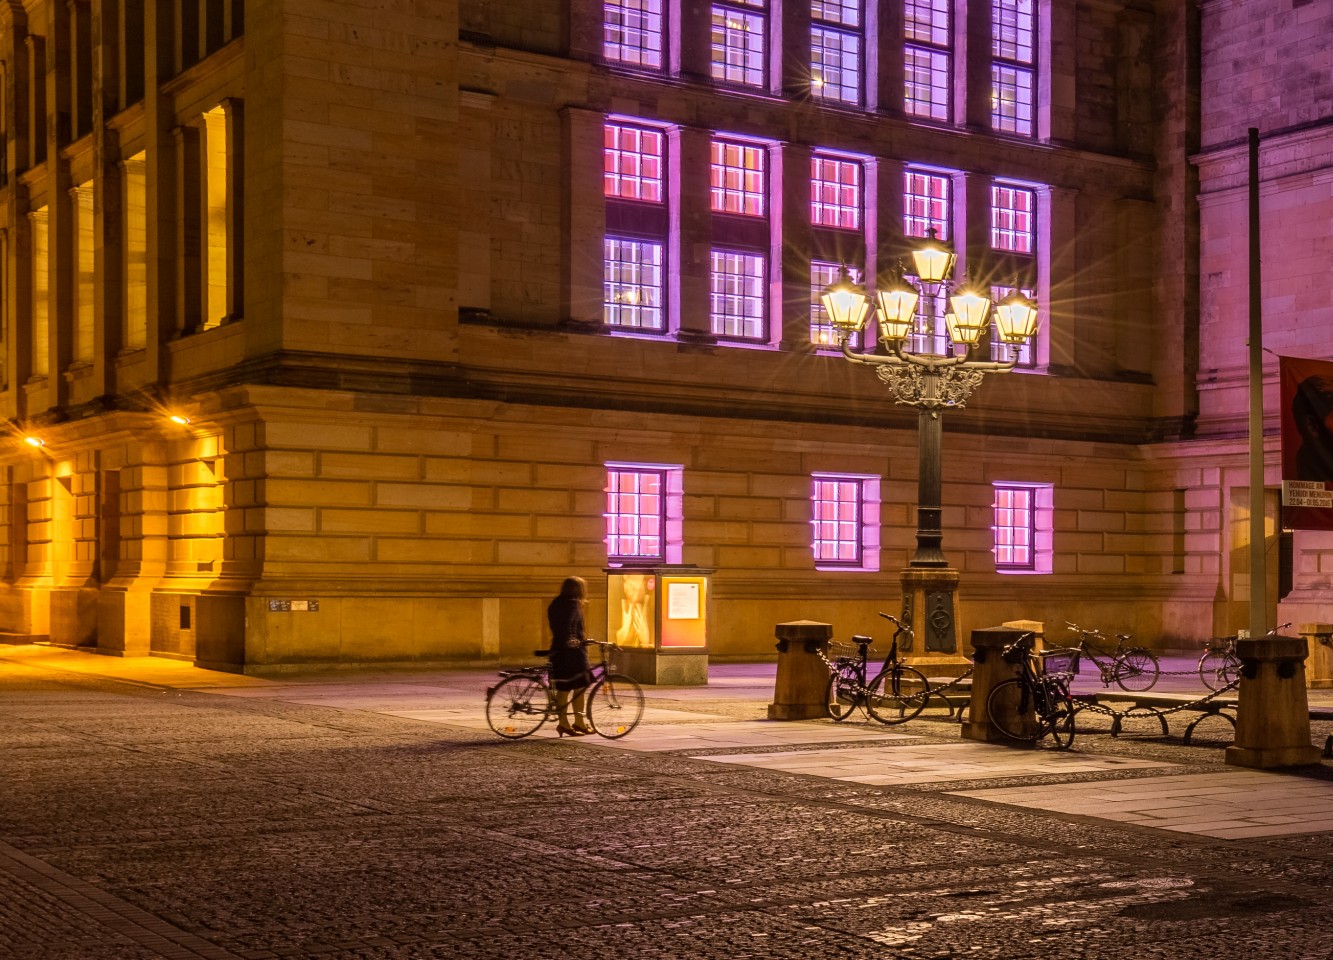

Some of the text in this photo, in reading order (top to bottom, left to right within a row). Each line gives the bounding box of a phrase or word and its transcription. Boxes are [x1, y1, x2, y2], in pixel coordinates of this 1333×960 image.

[1288, 481, 1323, 490] HOMMAGE AN
[1288, 489, 1332, 499] YEHUDI MENUHIN
